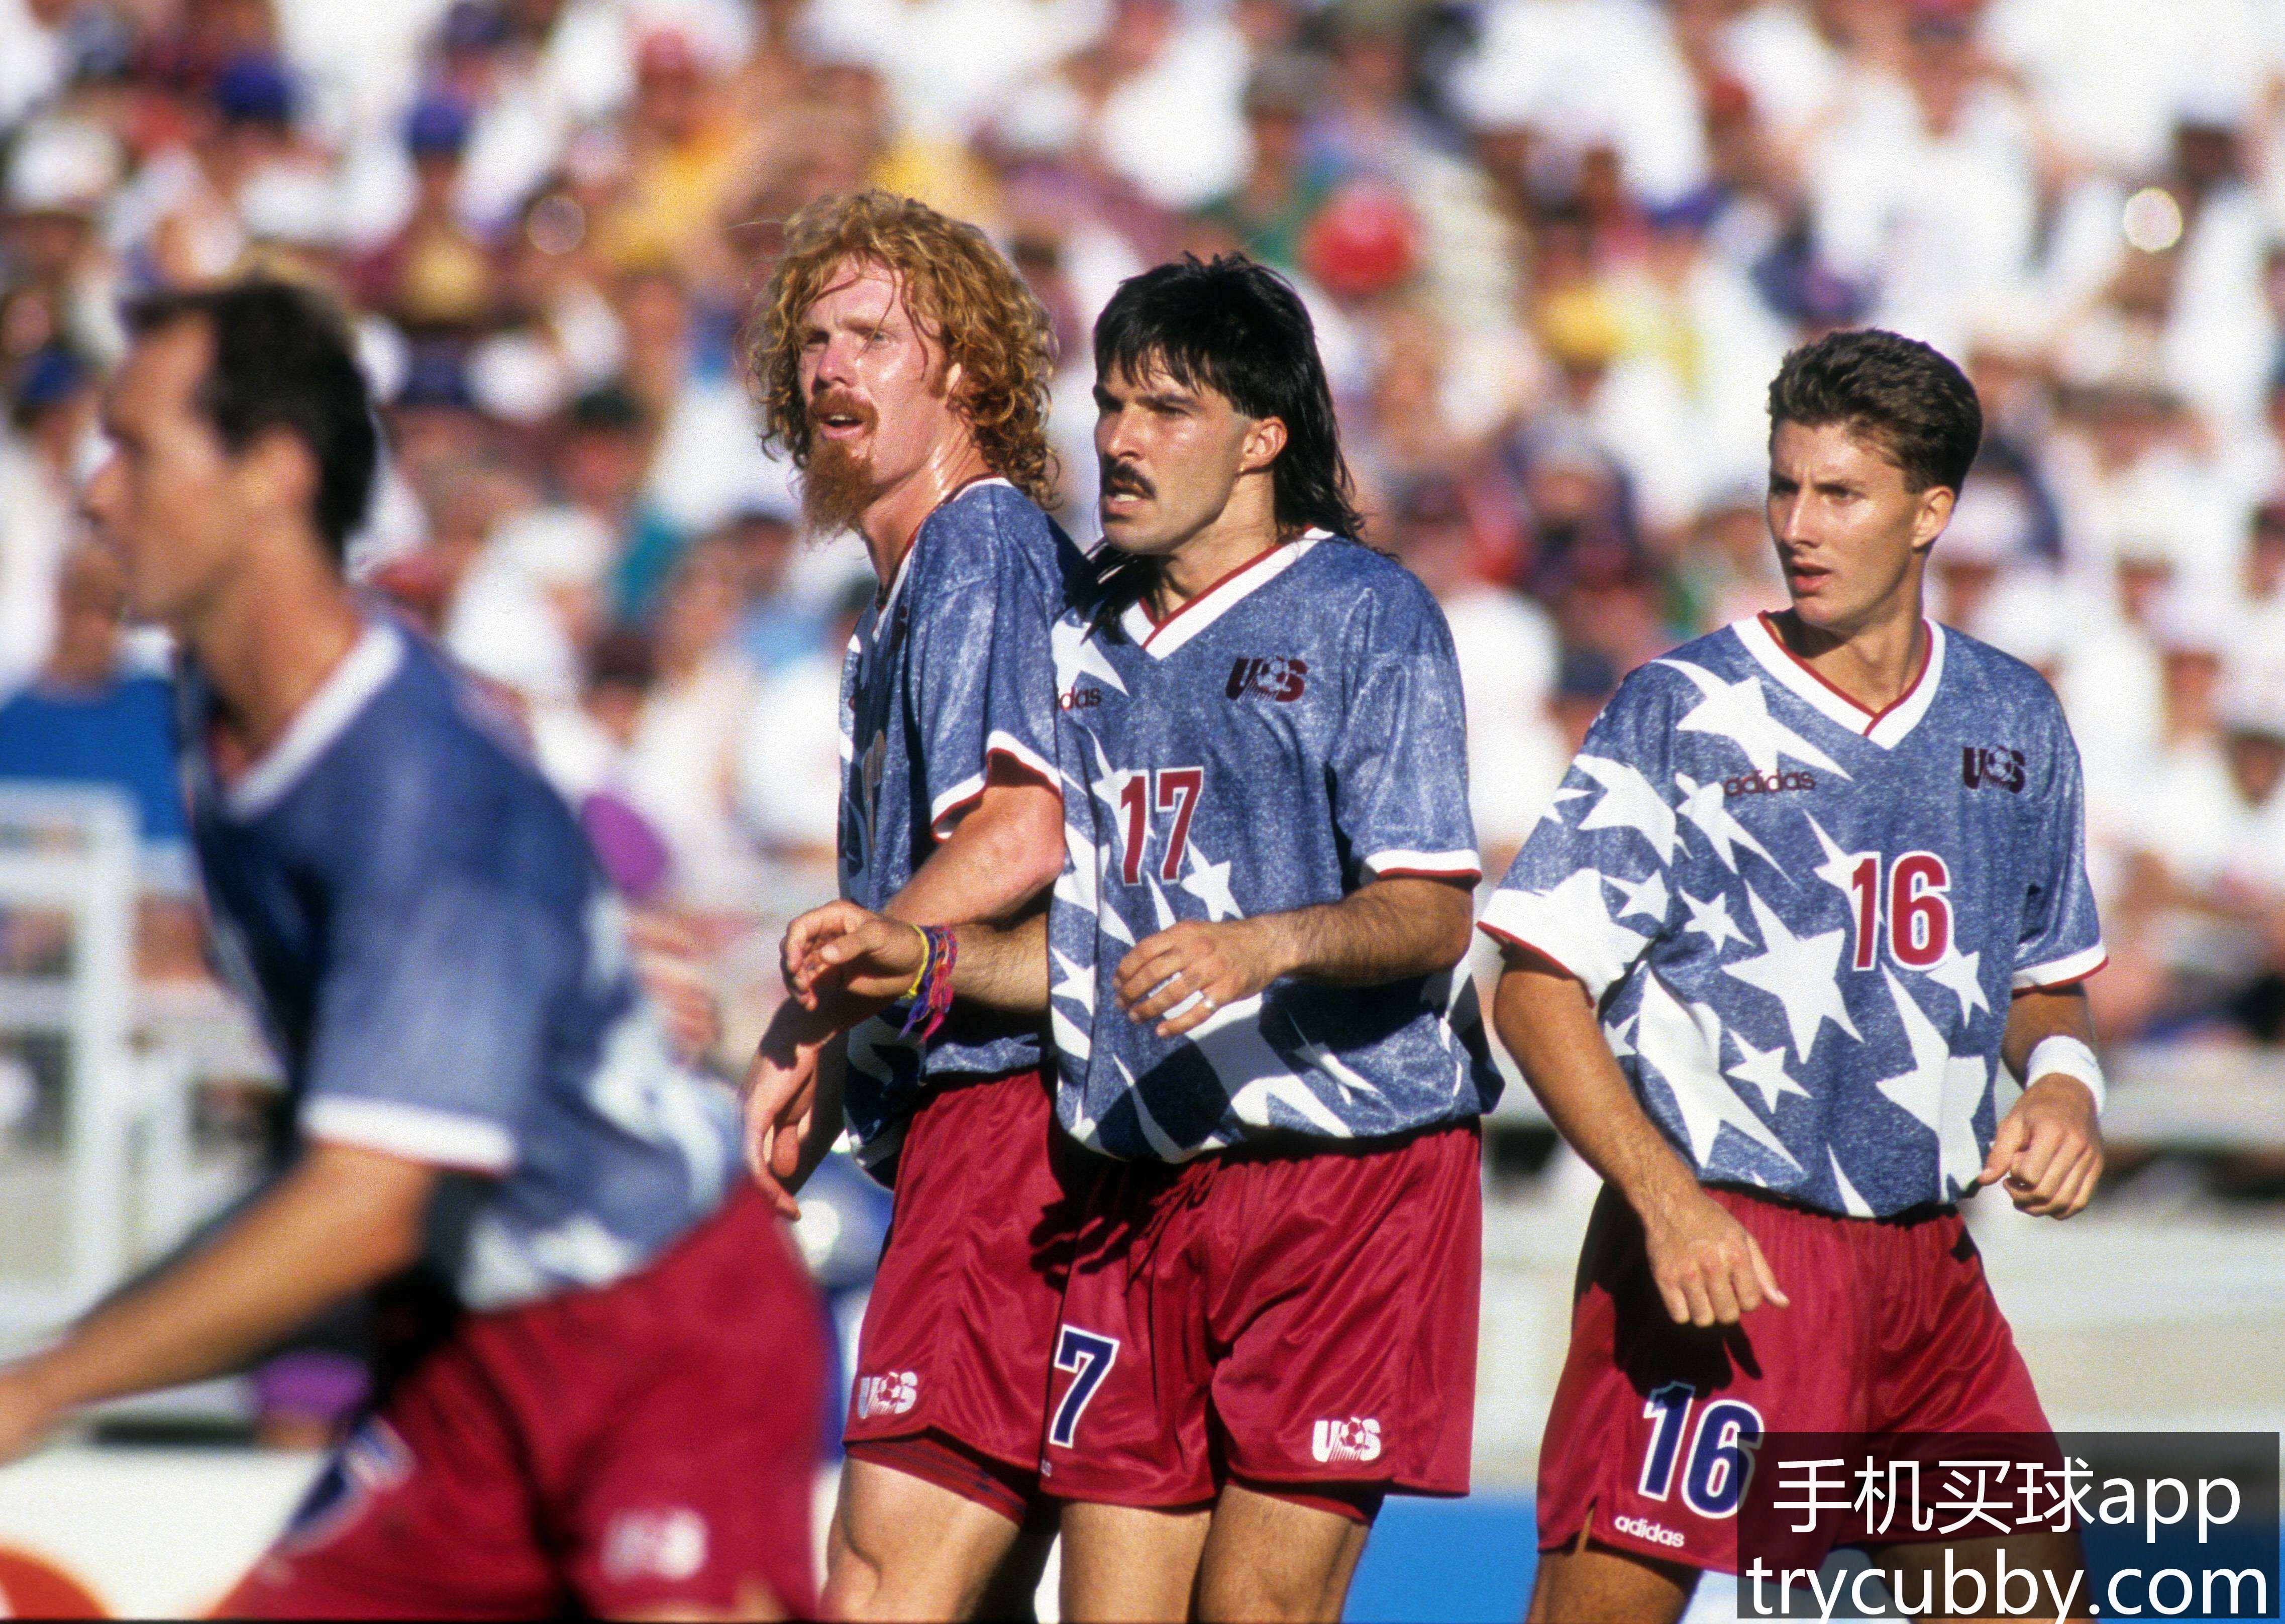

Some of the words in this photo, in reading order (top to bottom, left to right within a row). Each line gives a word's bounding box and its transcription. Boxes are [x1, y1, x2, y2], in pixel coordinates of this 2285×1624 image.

[1059, 686, 1102, 711] das
[1725, 770, 1815, 796] adidas
[1120, 766, 1204, 888] 17
[1851, 850, 1954, 972] 16
[1638, 1381, 1764, 1520] 16
[1614, 1516, 1685, 1548] adidas
